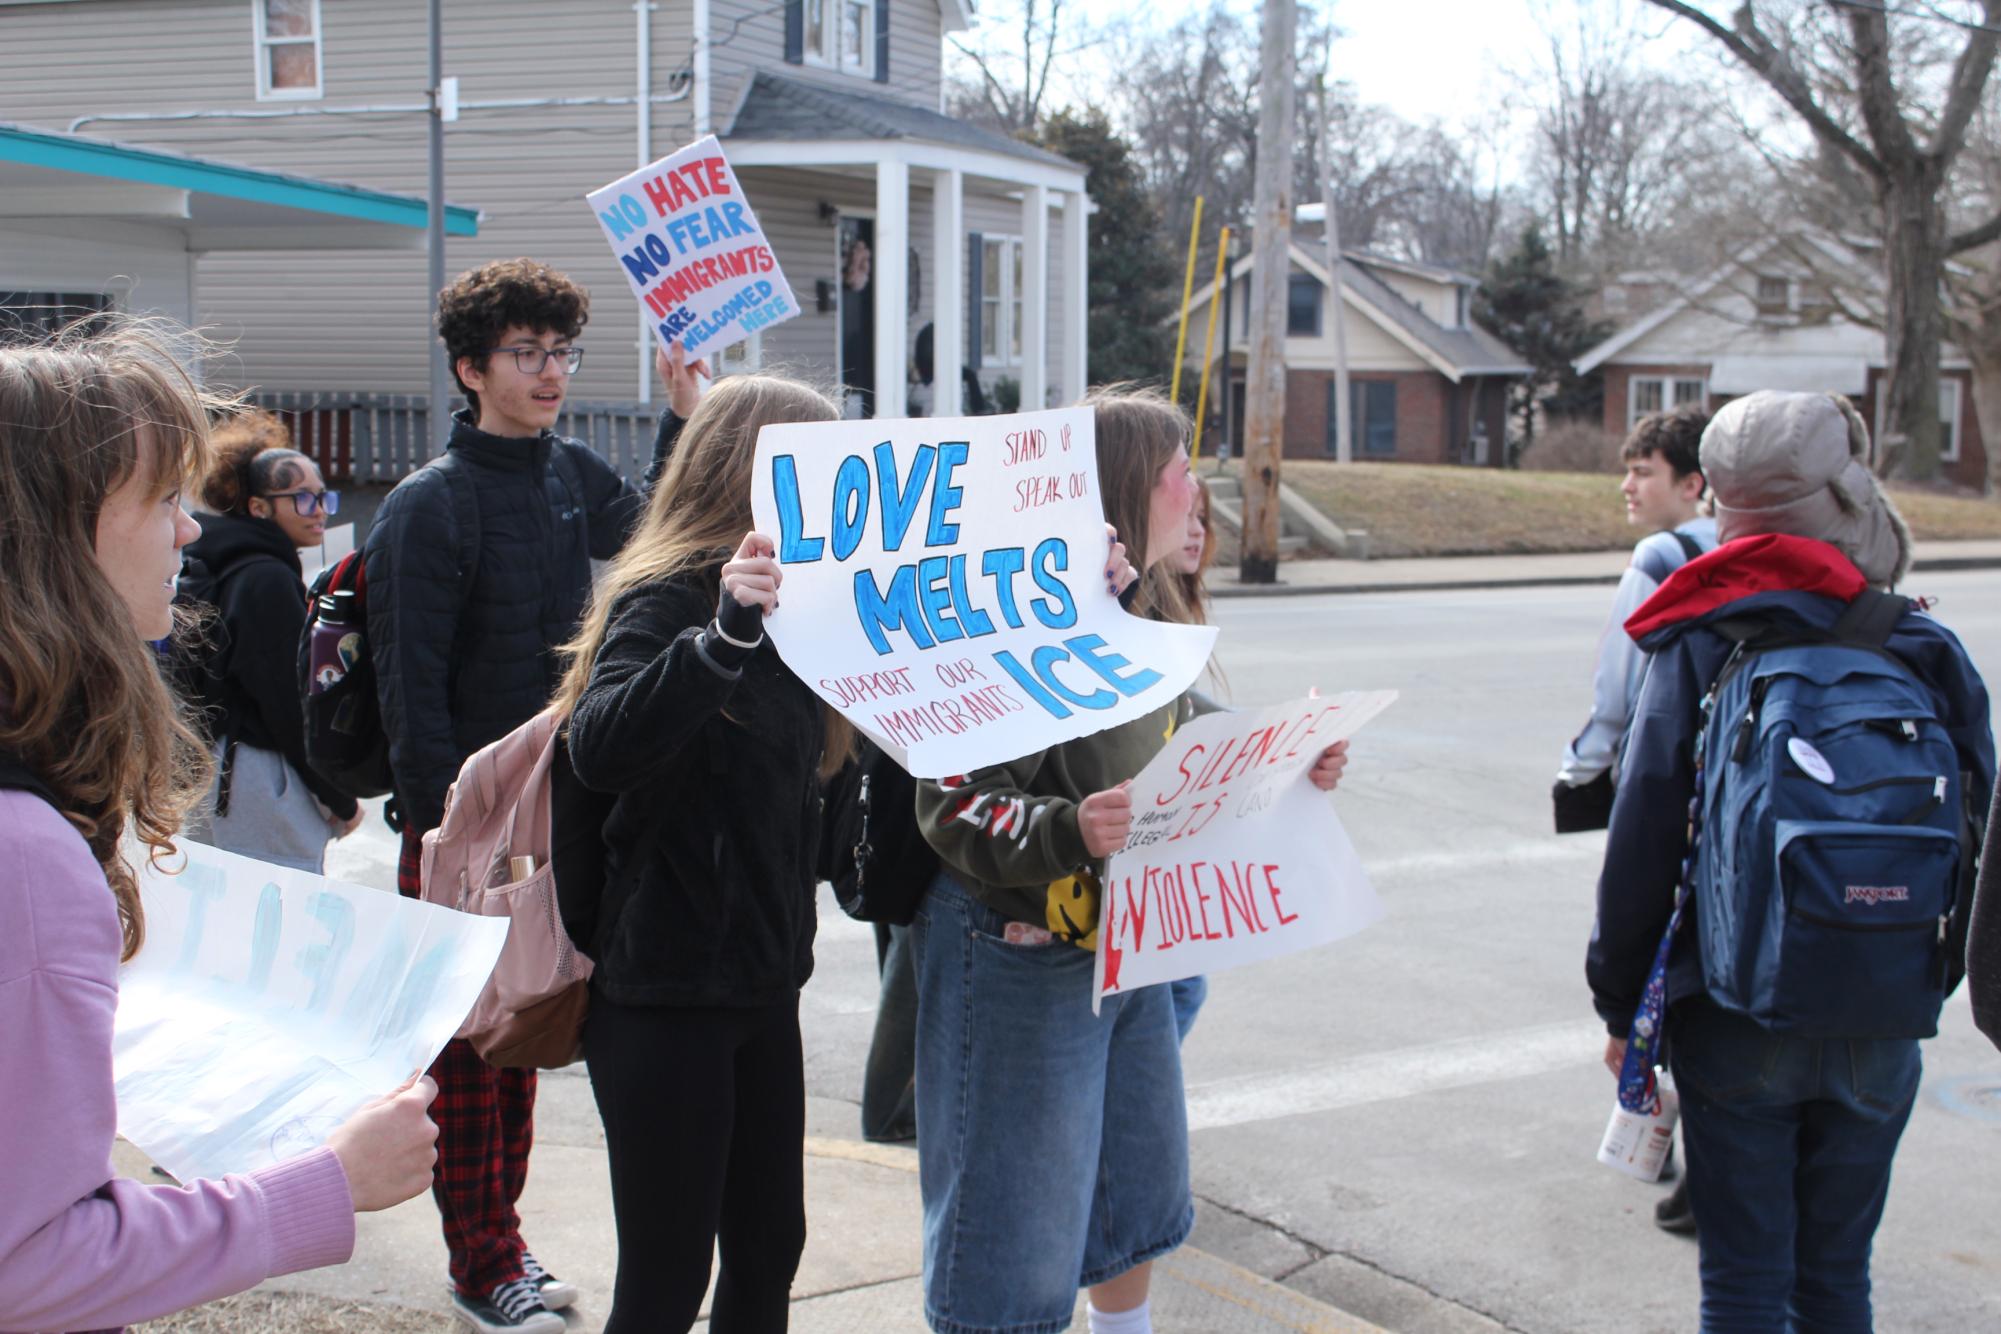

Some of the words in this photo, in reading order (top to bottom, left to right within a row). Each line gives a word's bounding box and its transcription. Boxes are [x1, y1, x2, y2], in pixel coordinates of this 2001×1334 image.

[599, 193, 648, 241] NO
[643, 157, 731, 217] HATE
[621, 233, 671, 286] NO
[665, 201, 756, 255] FEAR
[643, 246, 774, 319] IMMIGRANTS
[681, 280, 773, 353] WELCOMED
[738, 295, 789, 333] HERE
[658, 306, 697, 344] ARE
[1003, 428, 1046, 467] STAND
[1060, 423, 1071, 452] UP
[772, 440, 970, 564] LOVE
[1013, 475, 1064, 512] SPEAK
[1069, 471, 1087, 499] OUT
[853, 537, 1078, 656] MELTS
[819, 666, 916, 708] SUPPORT
[936, 657, 988, 688] OUR
[991, 633, 1165, 720] ICE
[873, 684, 1025, 747] IMMIGRANTS
[1156, 706, 1342, 806] SILENCE
[1168, 792, 1229, 842] IS
[1120, 861, 1298, 953] VIOLENCE
